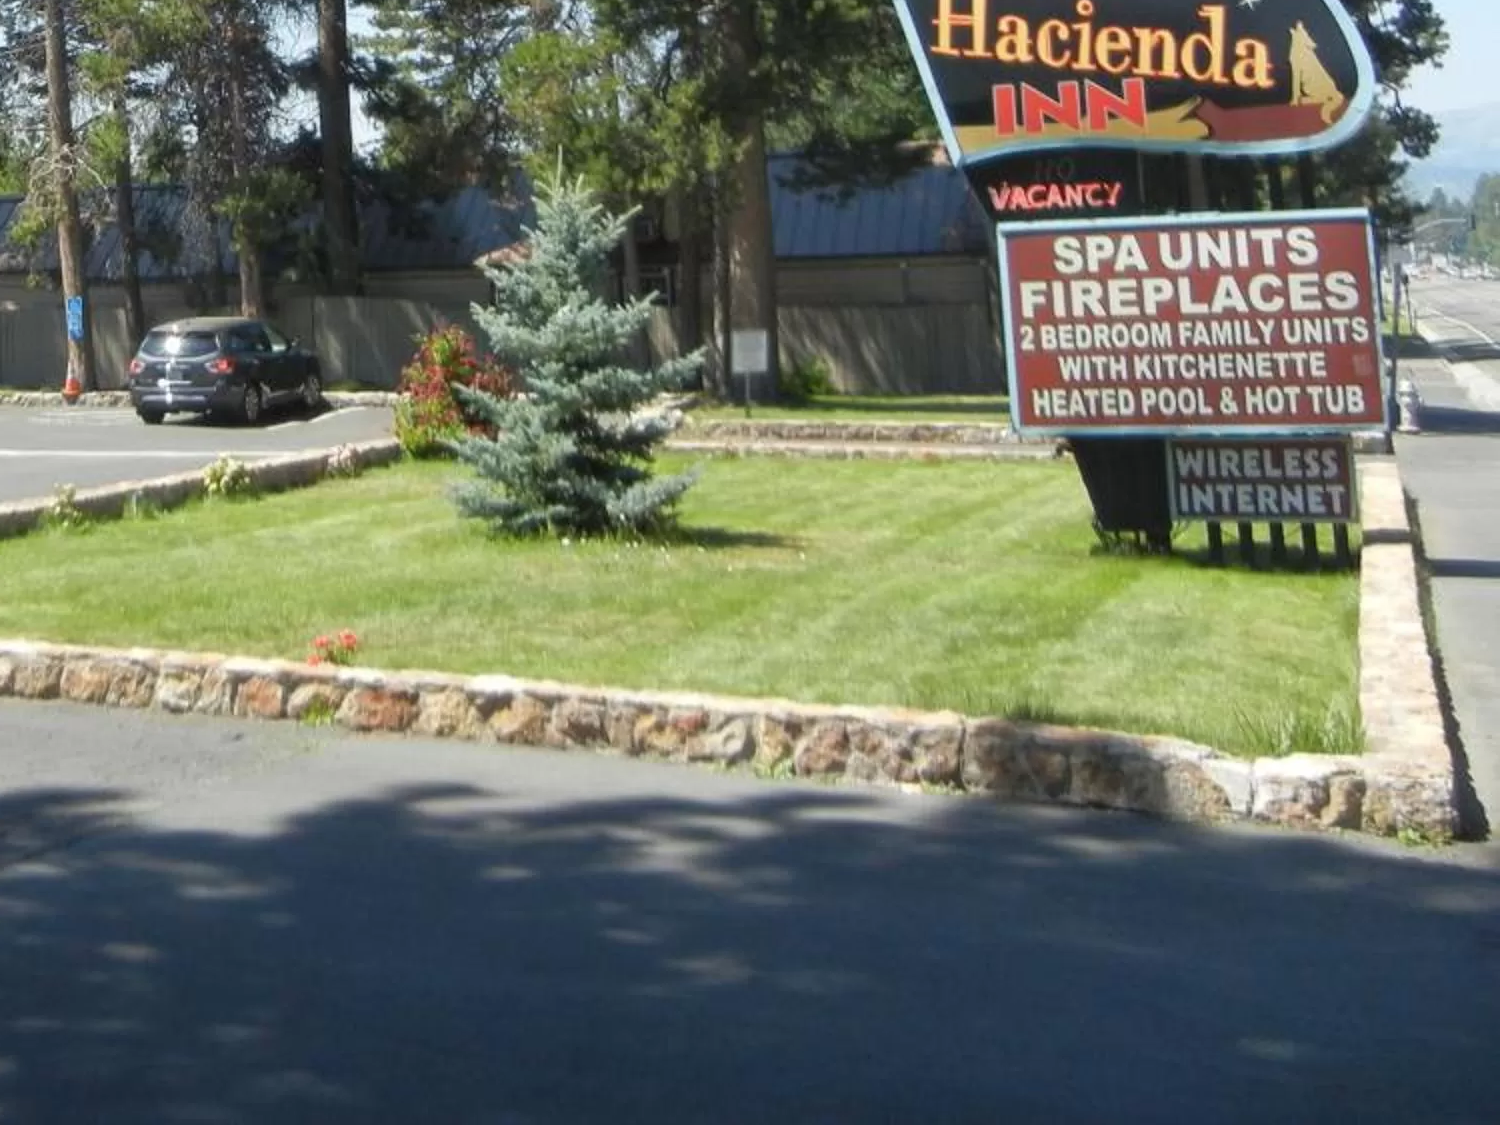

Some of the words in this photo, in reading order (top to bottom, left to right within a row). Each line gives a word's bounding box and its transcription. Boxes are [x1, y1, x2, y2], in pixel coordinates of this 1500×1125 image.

[992, 78, 1148, 136] INN
[988, 181, 1122, 211] VACANCY
[1054, 234, 1148, 274] SPA
[1159, 227, 1319, 269] UNITS
[1020, 271, 1359, 318] FIREPLACES
[1020, 327, 1035, 351] 2
[1041, 322, 1171, 351] BEDROOM
[1179, 319, 1275, 348] FAMILY
[1283, 317, 1369, 344] UNITS
[1058, 355, 1128, 382] WITH
[1133, 352, 1327, 380] KITCHENETTE
[1032, 388, 1135, 417] HEATED
[1141, 387, 1213, 416] POOL
[1220, 386, 1238, 414] &
[1245, 386, 1301, 414] HOT
[1306, 384, 1365, 413] TUB
[1176, 448, 1339, 479] WIRELESS
[1179, 483, 1345, 514] INTERNET
